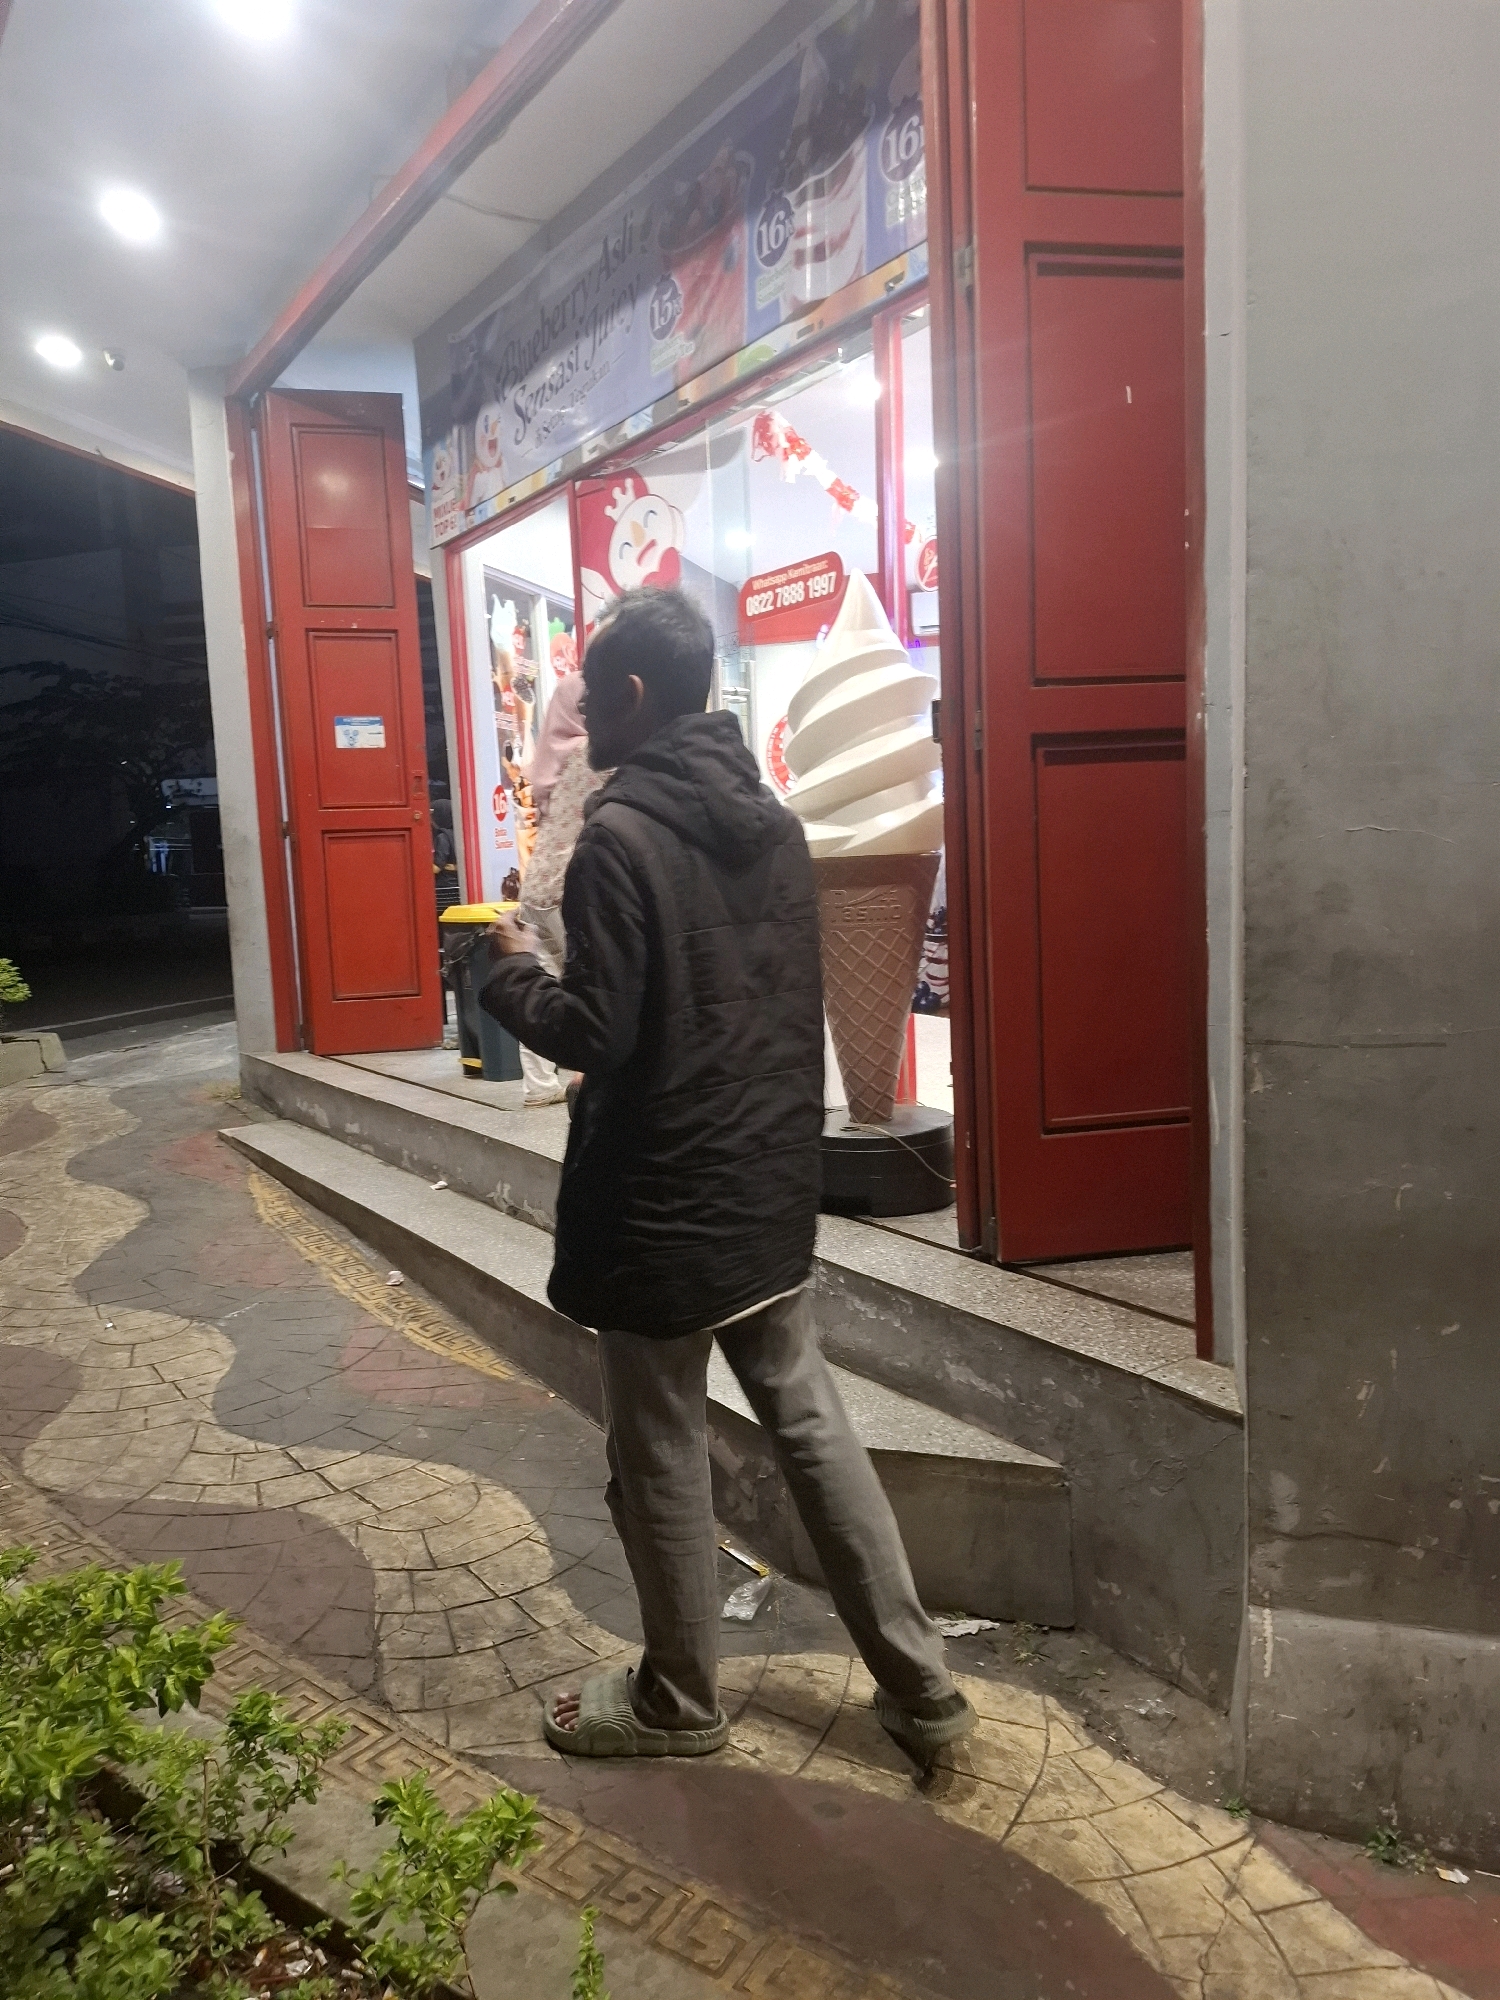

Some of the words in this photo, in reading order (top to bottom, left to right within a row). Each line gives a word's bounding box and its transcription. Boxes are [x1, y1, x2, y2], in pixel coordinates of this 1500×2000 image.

[494, 272, 592, 403] Blueberry
[513, 329, 580, 445] Sensasi
[583, 274, 641, 371] Juicy
[746, 591, 774, 617] 0822
[775, 581, 805, 608] 7888
[806, 571, 836, 599] 1997
